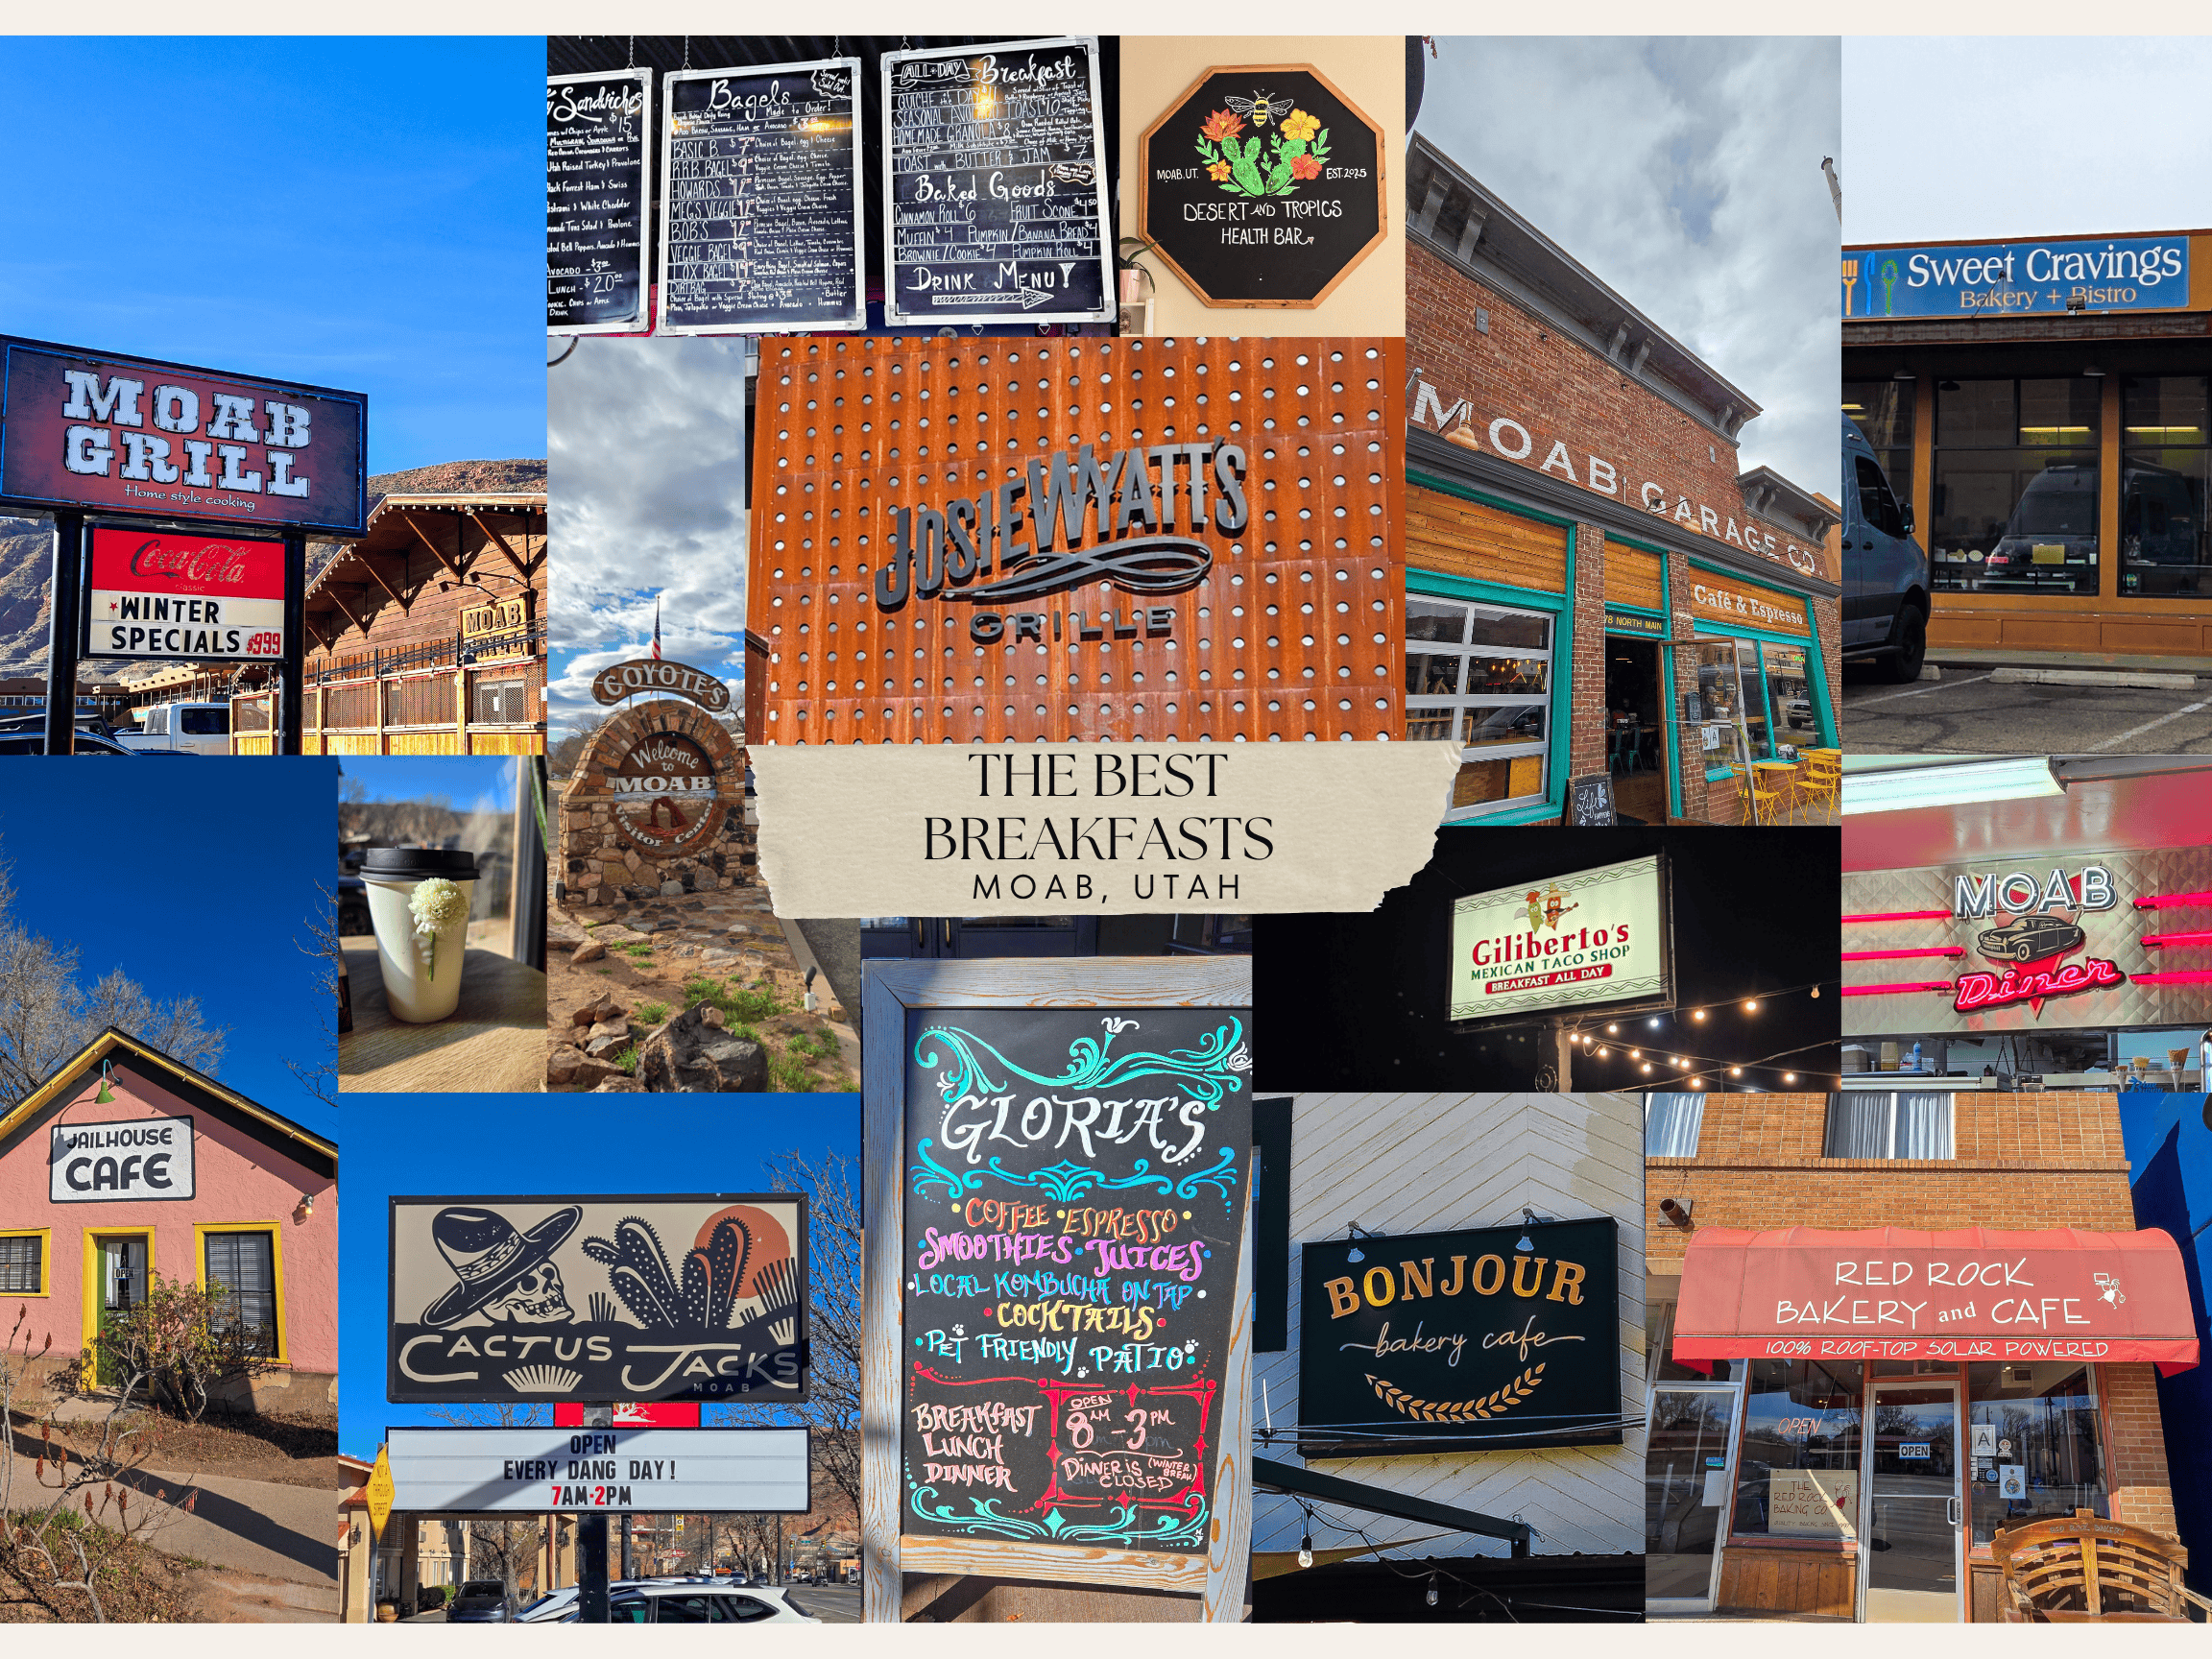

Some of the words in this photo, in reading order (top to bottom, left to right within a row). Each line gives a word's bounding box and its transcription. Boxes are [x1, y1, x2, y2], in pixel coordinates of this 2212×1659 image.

[979, 53, 1076, 86] Breakfast
[553, 85, 642, 122] Sandwiches
[707, 79, 790, 121] Bagels
[766, 107, 784, 116] Made
[792, 105, 799, 114] to
[805, 101, 831, 113] Order!
[898, 92, 937, 109] QUICHE
[894, 108, 944, 129] SEASONAL
[674, 141, 704, 158] BASIC
[893, 155, 931, 172] TOAST
[955, 151, 1000, 169] BUTTER
[1020, 147, 1051, 163] JAM
[563, 160, 583, 171] Raised
[585, 160, 606, 171] Turkey
[612, 157, 640, 167] Provolone
[672, 180, 720, 199] HOWARDS
[915, 174, 977, 202] Baked
[990, 170, 1055, 202] Goods
[581, 201, 600, 210] White
[602, 198, 630, 209] Cheddar
[672, 200, 702, 219] MEG'S
[706, 200, 736, 218] VEGGIE
[895, 205, 934, 224] CINNAMON
[939, 204, 959, 222] ROLL
[1184, 203, 1249, 221] DESERT
[1251, 204, 1275, 217] AND
[1282, 200, 1342, 218] TROPICS
[672, 221, 709, 241] BOB'S
[898, 228, 934, 245] MUFFIN
[1221, 228, 1267, 244] HEALTH
[1274, 228, 1308, 244] BAR
[906, 267, 976, 291] DRINK
[1907, 251, 2015, 287] Sweet
[2026, 244, 2182, 285] Cravings
[548, 280, 576, 294] LUNCH
[1960, 289, 2038, 309] Bakery
[2071, 284, 2136, 304] Bistro
[63, 370, 311, 448] MOAB
[65, 424, 309, 498] GRILL
[1410, 379, 1618, 495] MOAB
[1640, 481, 1780, 560] GARAGE
[125, 483, 166, 502] Home
[170, 489, 202, 506] style
[205, 493, 255, 512] cooking
[121, 596, 219, 623] WINTER
[1694, 584, 1731, 611] Café
[1736, 595, 1747, 613] &
[1749, 598, 1803, 624] Espresso
[466, 603, 521, 633] MOAB
[969, 606, 1173, 643] GRILLE
[1616, 617, 1642, 628] NORTH
[1645, 620, 1662, 630] MAIN
[111, 626, 240, 653] SPECIALS
[603, 663, 725, 706] COYOTE'S
[631, 739, 699, 768] Welcome
[661, 761, 674, 771] to
[614, 776, 711, 792] MOAB
[615, 805, 663, 847] Visitor
[675, 800, 712, 843] Center
[1955, 866, 2118, 920] MOAB
[1472, 925, 1629, 966] Giliberto's
[1471, 961, 1534, 980] MEXICAN
[1541, 953, 1583, 970] TACO
[1590, 945, 1630, 962] SHOP
[1491, 975, 1550, 992] BREAKFAST
[1554, 972, 1576, 984] ALL
[1581, 967, 1604, 979] DAY
[1955, 959, 2125, 1010] Diner
[66, 1127, 172, 1149] JAILHOUSE
[941, 1094, 1206, 1165] GLORIA'S
[65, 1153, 173, 1190] CAFE
[966, 1198, 1050, 1235] COFFEE
[1063, 1208, 1178, 1243] ESPRESSO
[919, 1227, 1072, 1269] SMOOTHIES
[1086, 1238, 1205, 1282] JUICES
[116, 1268, 133, 1277] OPEN
[1835, 1262, 1912, 1286] RED
[1927, 1257, 2034, 1287] ROCK
[913, 1273, 989, 1298] LOCAL
[994, 1270, 1111, 1304] KOMBUCHA
[1122, 1280, 1150, 1311] ON
[1153, 1285, 1192, 1310] TAP
[1323, 1254, 1587, 1320] BONJOUR
[998, 1300, 1154, 1339] COCKTAILS
[1775, 1295, 1927, 1330] BAKERY
[1938, 1302, 1976, 1324] and
[1991, 1298, 2091, 1330] CAFE
[926, 1331, 969, 1363] PET
[975, 1333, 1077, 1376] FRIENDLY
[1089, 1343, 1185, 1373] PATIO
[1340, 1321, 1468, 1367] bakery
[1482, 1314, 1586, 1362] cafe
[1765, 1341, 1812, 1356] 100%
[1820, 1341, 1917, 1357] ROOF-TOP
[1926, 1340, 1997, 1356] SOLAR
[2006, 1341, 2108, 1358] POWERED
[398, 1334, 613, 1382] CACTUS
[621, 1343, 800, 1392] JACKS
[693, 1383, 751, 1392] MOAB
[1070, 1395, 1112, 1409] OPEN
[911, 1402, 1043, 1435] BREAKFAST
[1778, 1418, 1822, 1434] OPEN
[569, 1434, 616, 1455] OPEN
[923, 1433, 1003, 1464] LUNCH
[1901, 1445, 1929, 1457] OPEN
[1978, 1432, 1990, 1446] A
[503, 1459, 556, 1480] EVERY
[568, 1459, 616, 1480] DANG
[924, 1463, 1018, 1492] DINNER
[1099, 1476, 1173, 1489] CLOSED
[1773, 1493, 1795, 1502] RED
[1799, 1492, 1828, 1503] ROCK
[1791, 1480, 1811, 1492] THE
[1773, 1503, 1809, 1516] BAKING
